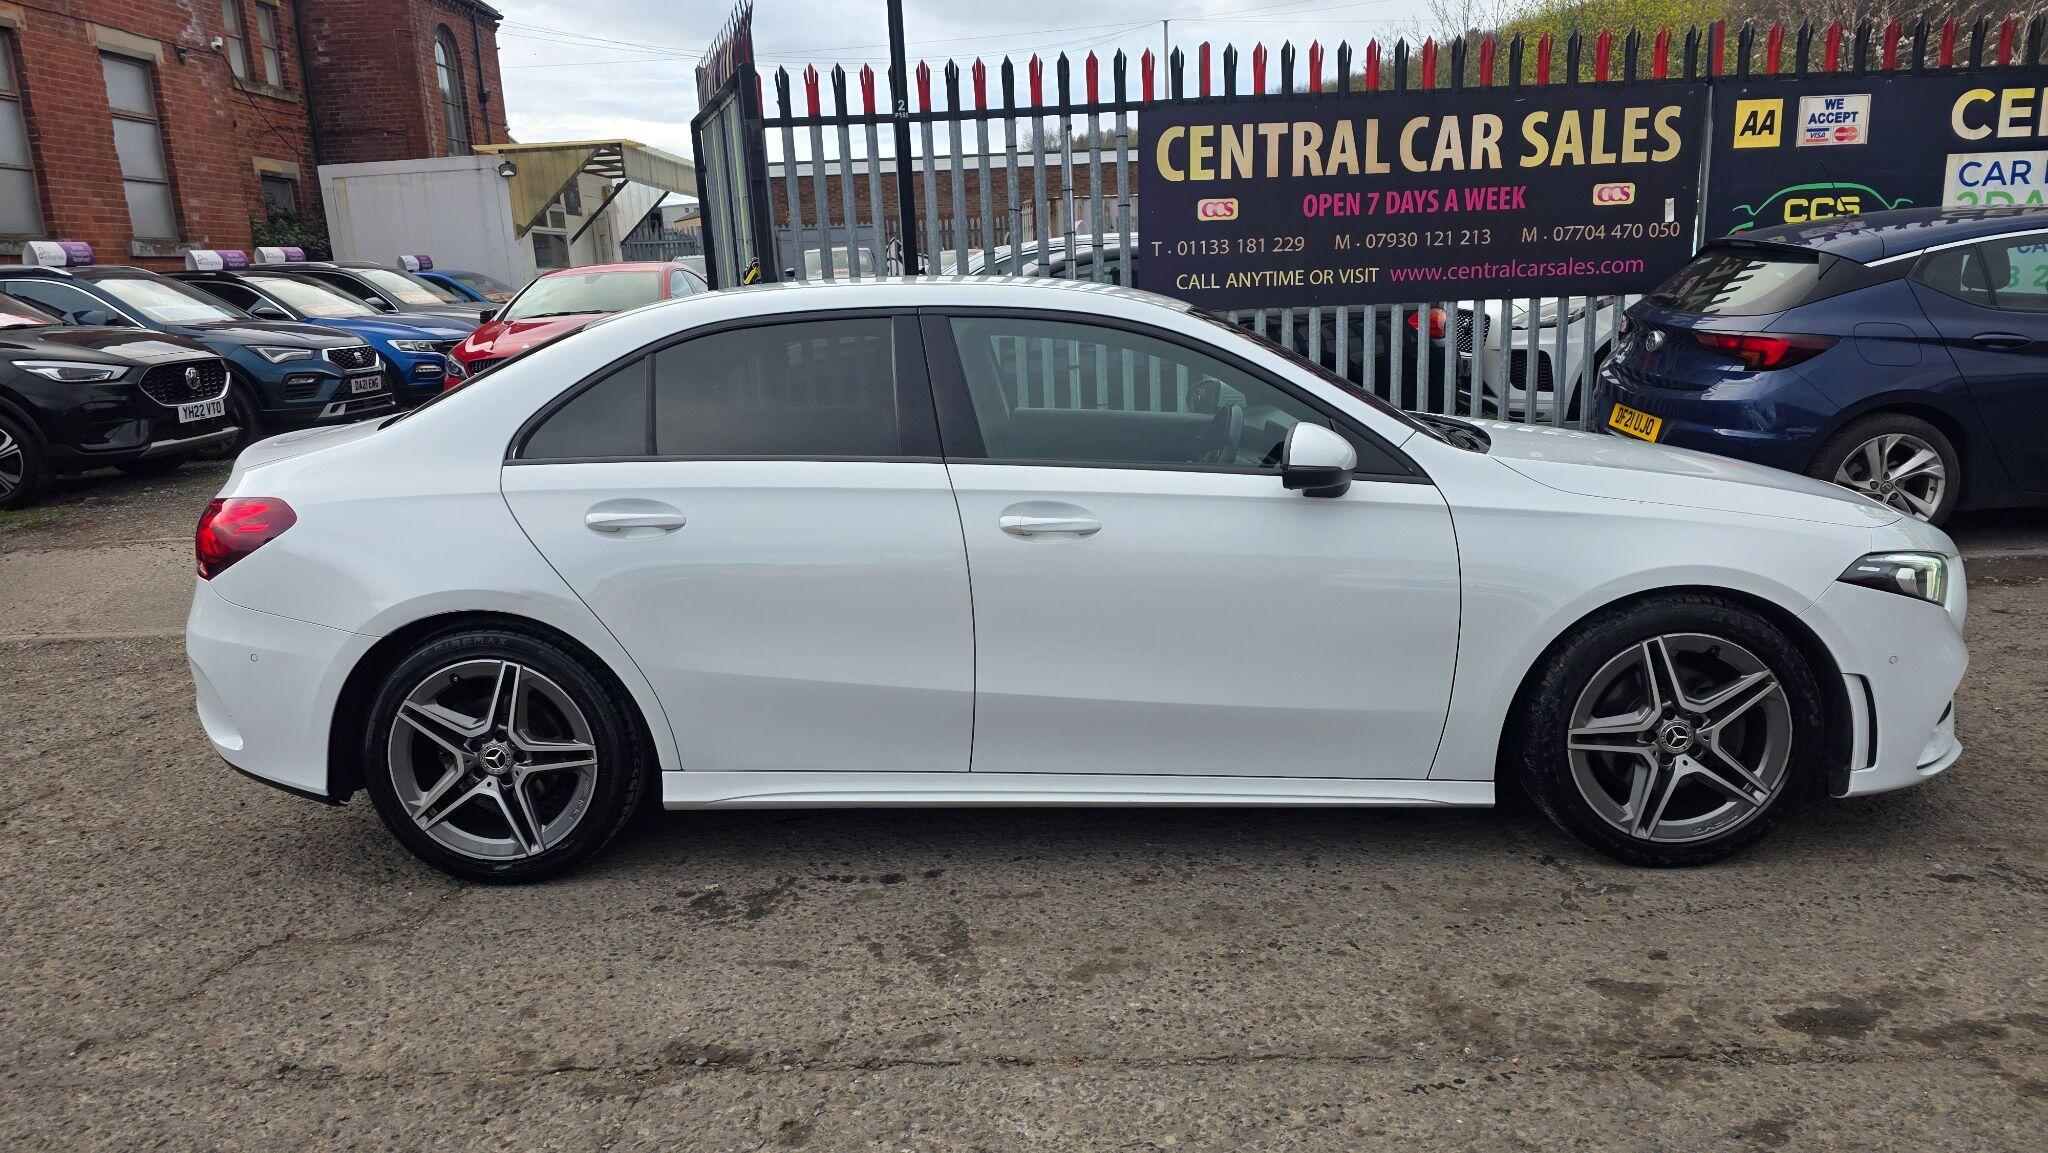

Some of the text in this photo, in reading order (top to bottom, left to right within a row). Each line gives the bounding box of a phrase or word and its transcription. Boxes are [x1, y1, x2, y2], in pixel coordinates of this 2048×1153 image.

[898, 100, 905, 111] 2
[1825, 98, 1845, 110] WE
[1951, 86, 2048, 140] CE
[1739, 109, 1776, 136] AA
[1808, 111, 1859, 125] ACCEPT
[1156, 105, 1682, 182] CENTRAL CAR SALES
[1810, 131, 1826, 139] VISA
[1958, 160, 2033, 187] CAR
[1302, 185, 1527, 218] OPEN 7 DAYS A WEEK
[1596, 185, 1631, 202] CCS
[1201, 201, 1234, 218] CCS
[1783, 196, 1862, 224] CCS
[1365, 231, 1418, 249] 07930
[1425, 230, 1452, 247] 121
[1460, 228, 1491, 245] 213
[1553, 224, 1605, 241] 07704
[1611, 223, 1643, 240] 470
[1649, 221, 1680, 238] 050
[1177, 239, 1230, 256] 01133
[1237, 237, 1265, 254] 181
[1272, 236, 1305, 252] 229
[1176, 256, 1644, 290] CALL ANYTIME OR VISIT www.centralcarsales.com
[182, 401, 222, 420] YH22 VTO
